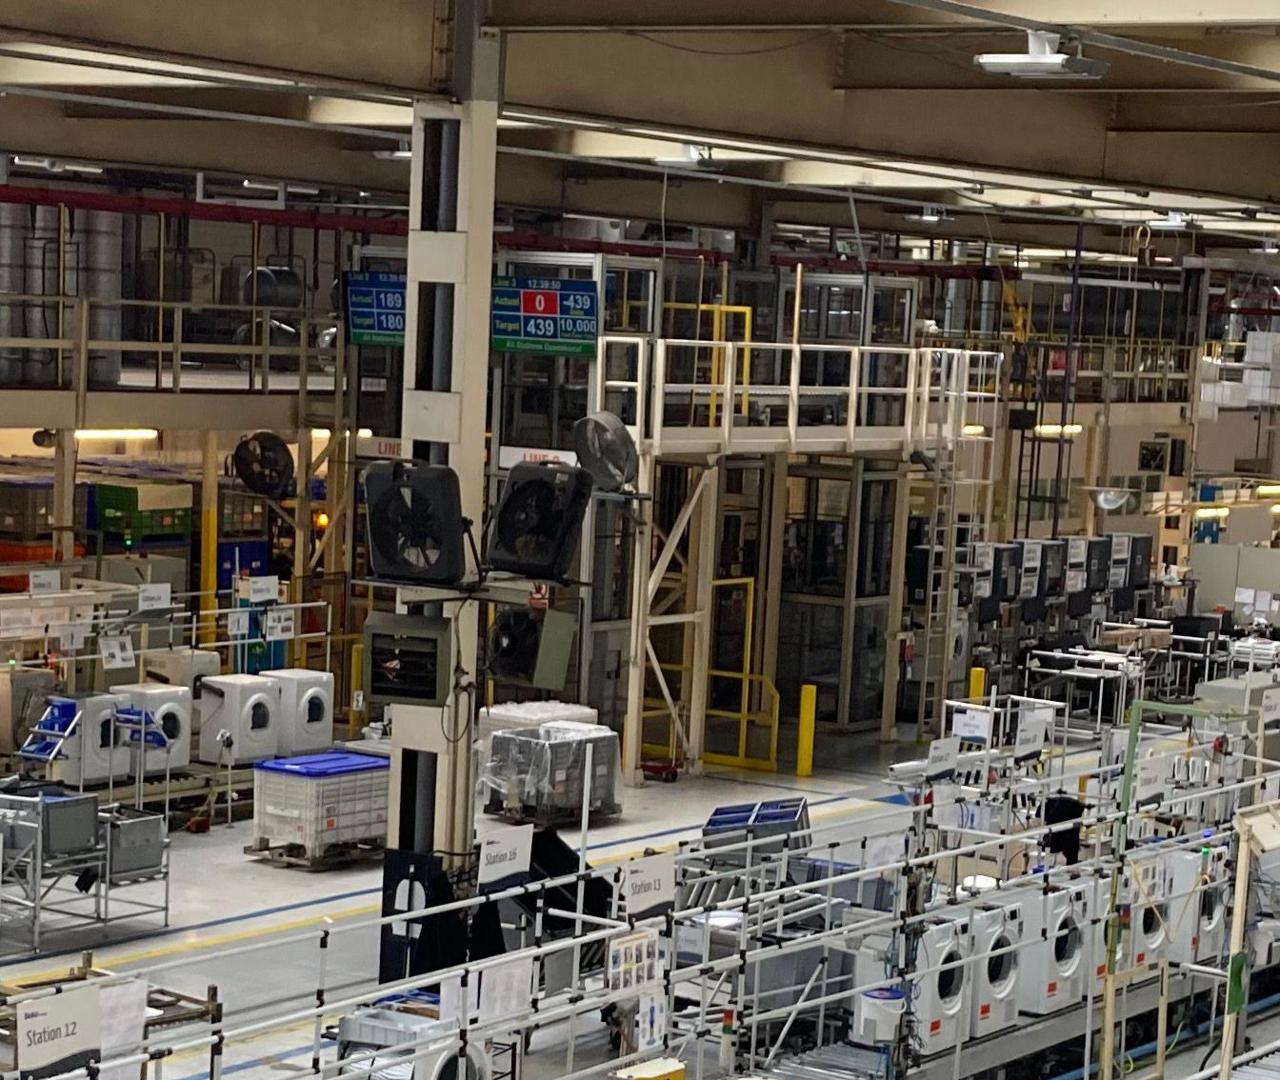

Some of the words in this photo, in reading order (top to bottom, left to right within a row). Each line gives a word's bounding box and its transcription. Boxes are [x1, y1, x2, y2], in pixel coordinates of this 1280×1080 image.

[380, 293, 402, 308] 189
[535, 295, 545, 311] 0
[563, 295, 590, 309] -439
[380, 314, 404, 330] 180
[527, 319, 554, 336] 439
[485, 851, 508, 866] Station
[631, 881, 653, 896] Station
[26, 1025, 62, 1047] Station
[65, 1021, 78, 1037] 12
